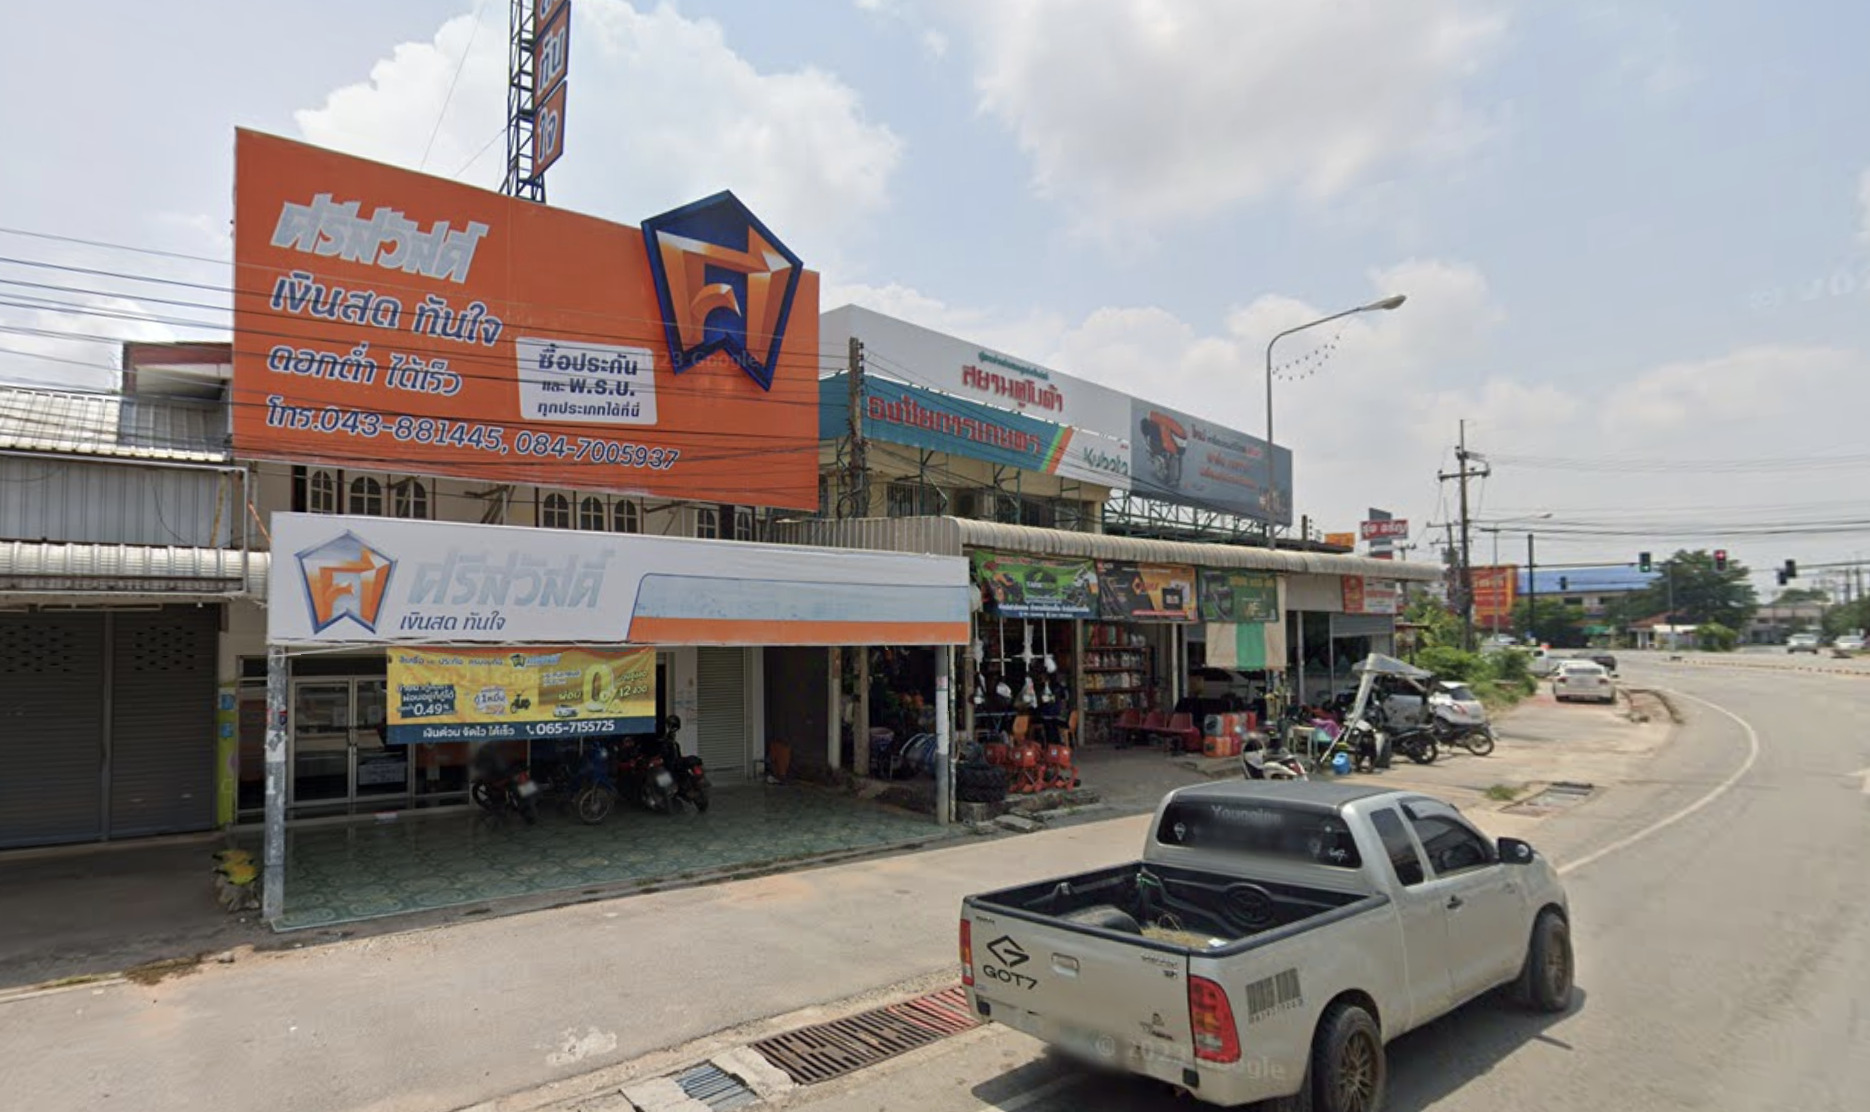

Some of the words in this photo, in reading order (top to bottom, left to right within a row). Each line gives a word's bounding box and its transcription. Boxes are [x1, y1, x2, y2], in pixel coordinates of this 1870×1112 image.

[270, 270, 402, 329] เงินสด
[411, 293, 503, 346] ทันใจ
[267, 341, 377, 384] ดอกต่ำ
[385, 352, 463, 396] ได้เร็ว
[539, 343, 637, 375] ซื้อประกัน
[542, 381, 565, 393] และ
[569, 378, 636, 397] พ.ร.บ.
[538, 401, 640, 417] ทุกประเภทได้ที่นี่
[515, 430, 679, 470] 084-7005937
[1083, 446, 1130, 475] Kubota
[400, 611, 457, 632] เงินสด
[462, 610, 506, 631] ทันใจ
[536, 719, 615, 736] 065-7155725
[983, 964, 1037, 990] GOT7
